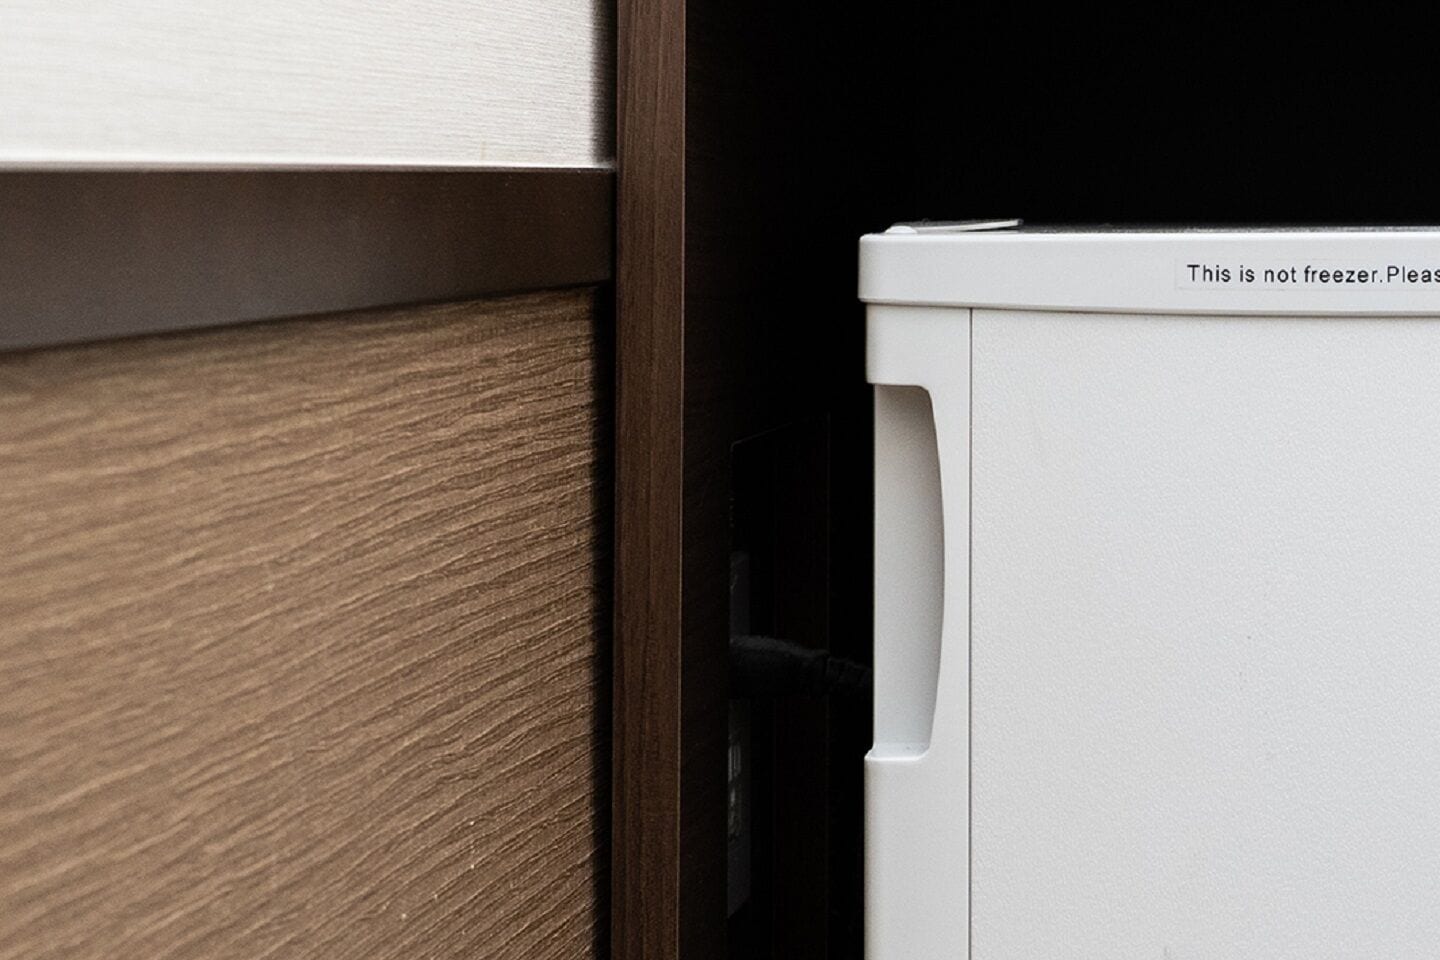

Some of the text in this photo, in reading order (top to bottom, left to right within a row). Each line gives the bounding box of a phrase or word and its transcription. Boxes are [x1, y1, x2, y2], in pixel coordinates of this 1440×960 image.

[1186, 264, 1232, 283] This
[1239, 264, 1255, 283] is
[1264, 267, 1297, 284] not
